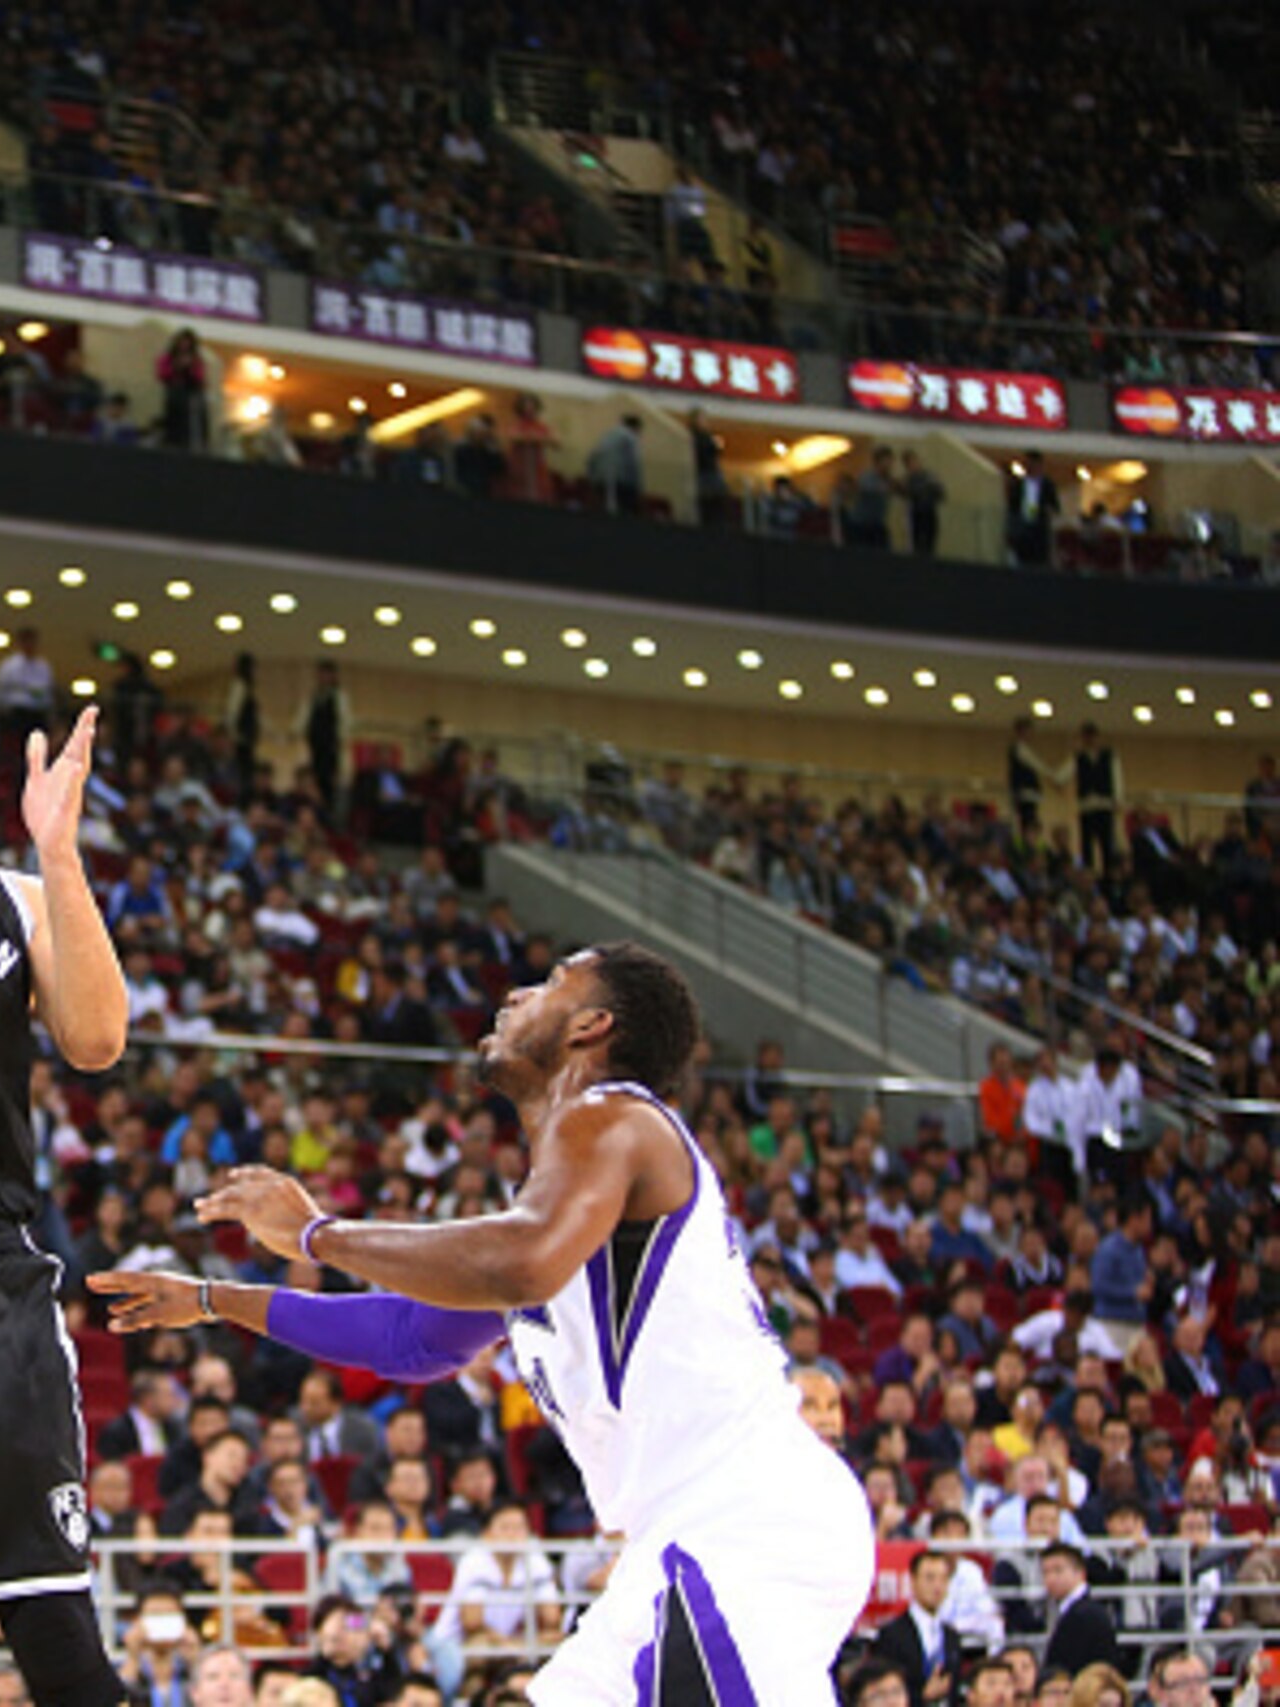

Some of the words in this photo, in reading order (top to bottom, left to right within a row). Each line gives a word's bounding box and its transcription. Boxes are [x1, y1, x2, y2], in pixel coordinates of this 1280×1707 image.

[652, 343, 794, 396] 万事达卡
[920, 373, 1063, 421] 万事达卡
